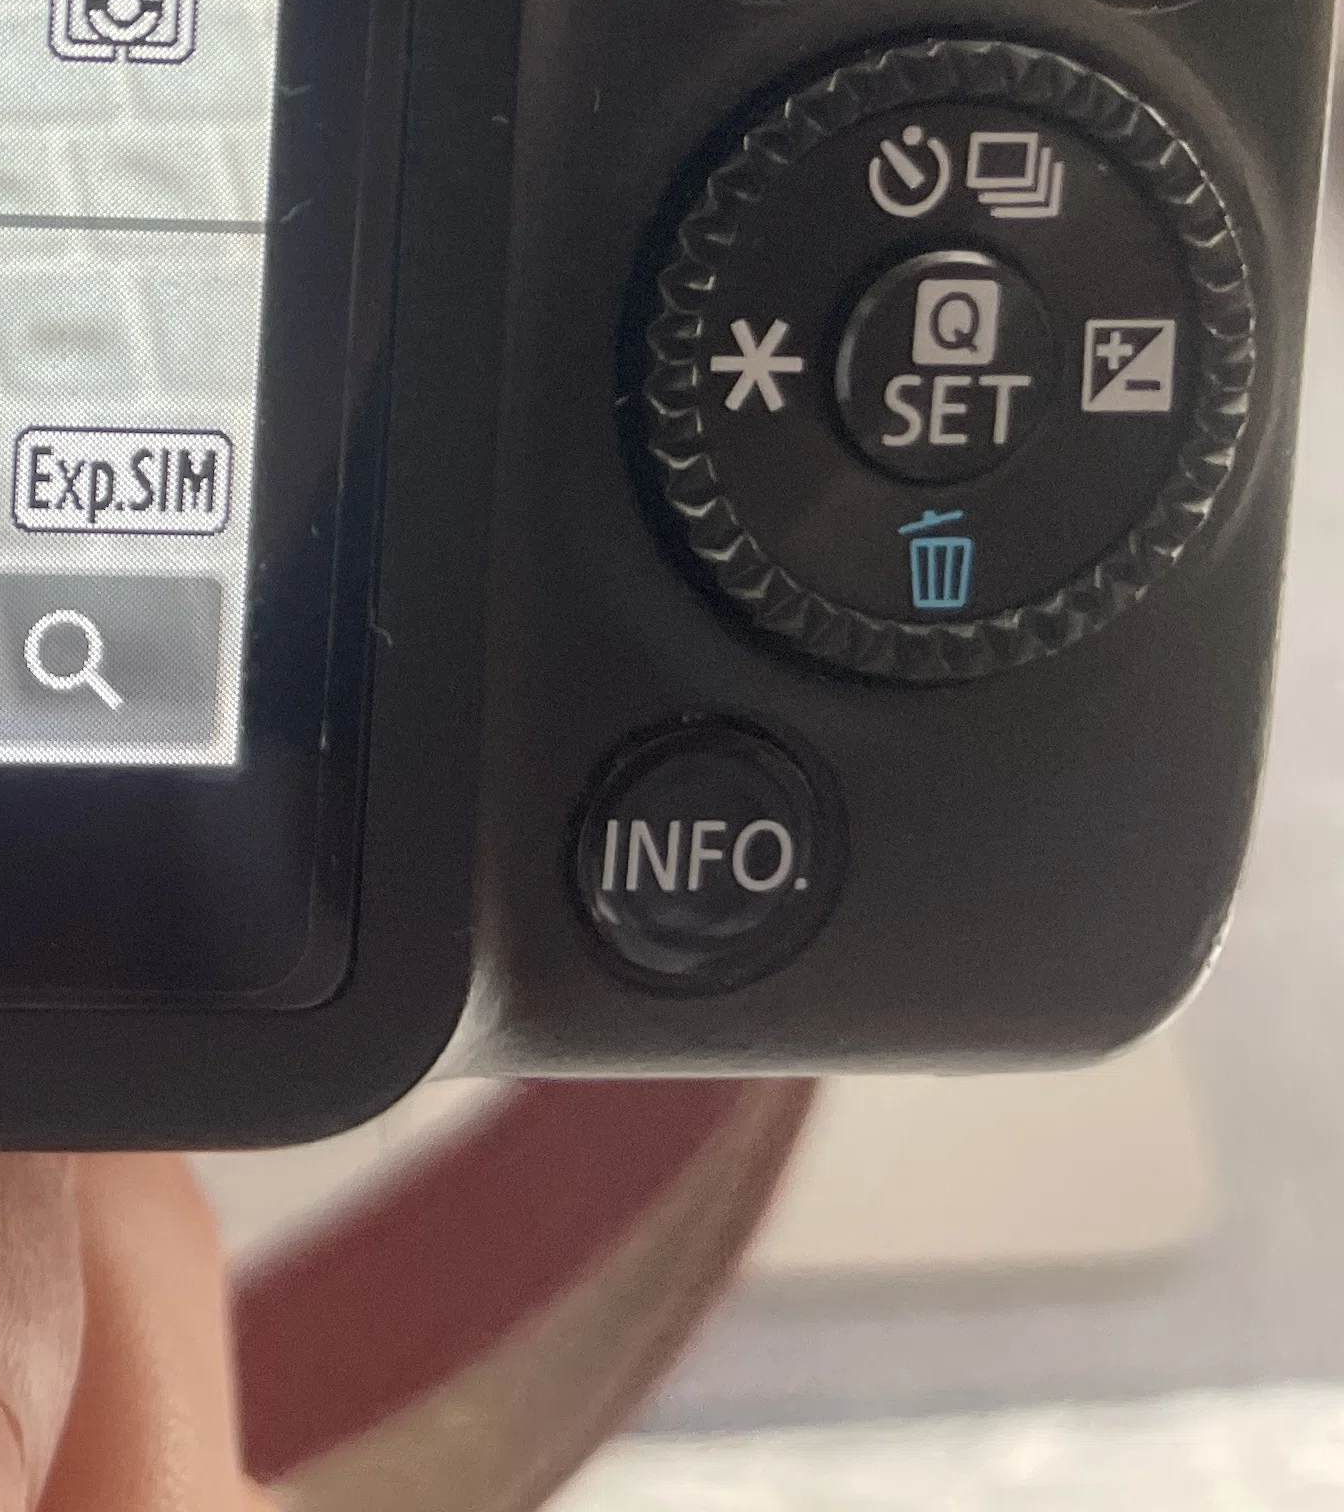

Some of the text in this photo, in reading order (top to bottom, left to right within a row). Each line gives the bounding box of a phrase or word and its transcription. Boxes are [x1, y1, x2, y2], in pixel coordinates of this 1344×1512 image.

[928, 291, 982, 355] Q
[882, 375, 1031, 447] SET
[27, 446, 216, 524] Exp.SIM
[600, 819, 809, 893] INFO.
